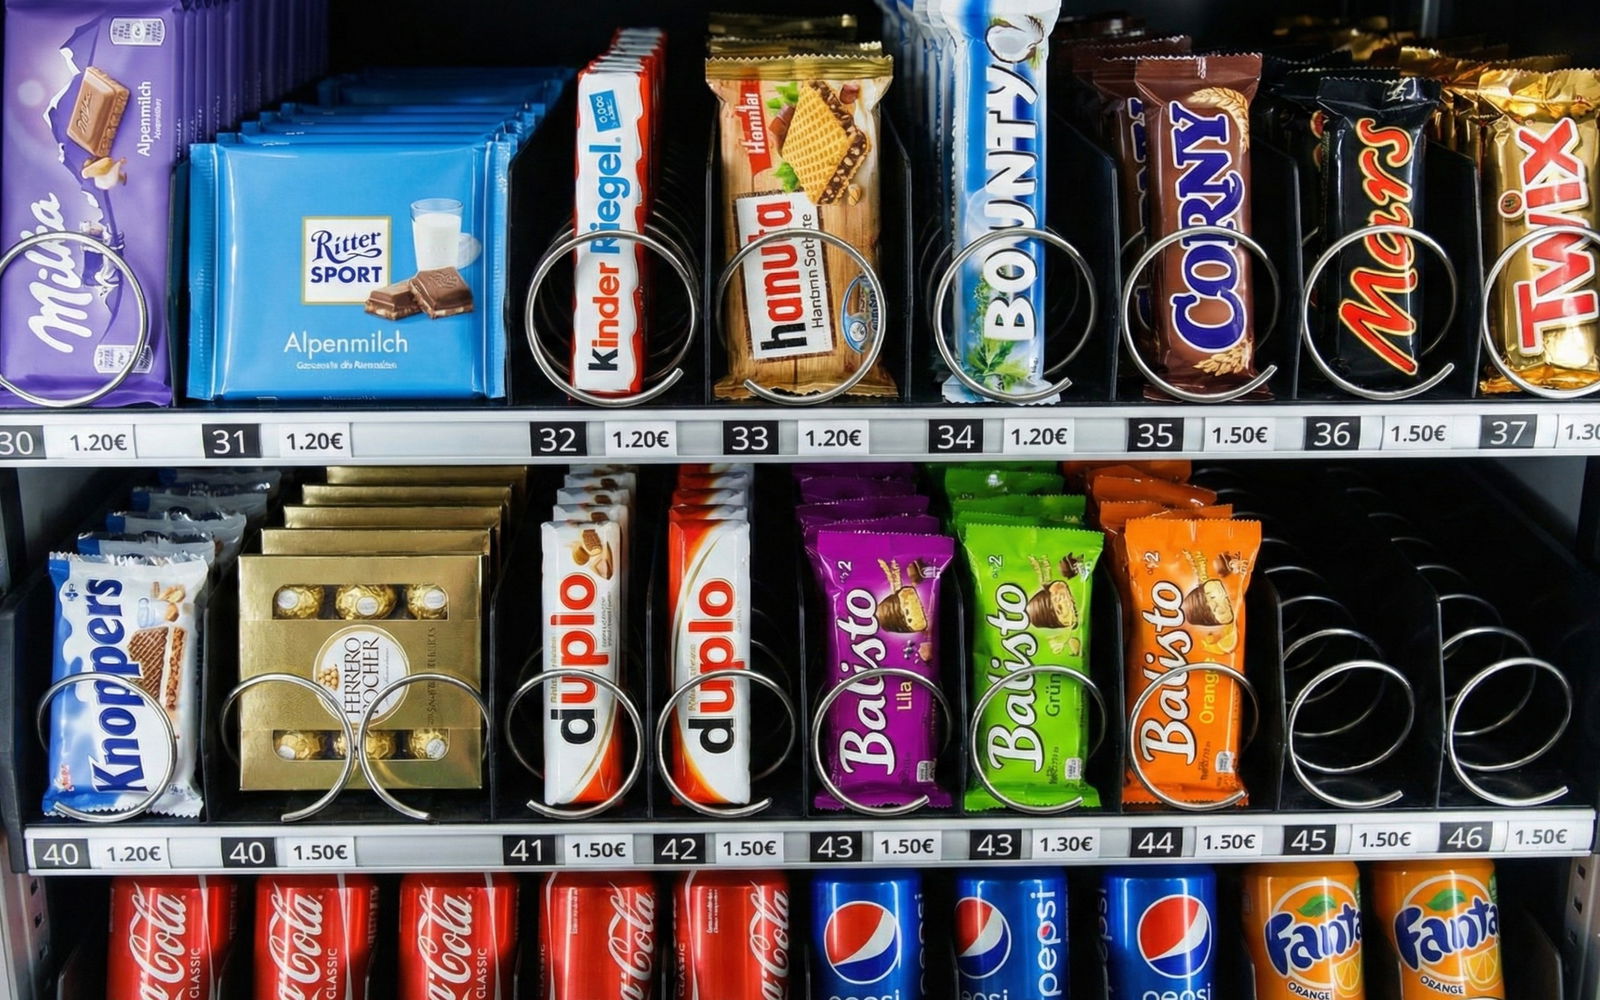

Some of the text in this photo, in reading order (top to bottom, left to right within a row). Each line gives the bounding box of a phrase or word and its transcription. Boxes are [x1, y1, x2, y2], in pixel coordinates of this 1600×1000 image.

[138, 81, 152, 157] Alpenmilch
[984, 63, 1038, 341] BOUNTY
[1169, 101, 1246, 353] CORNY
[311, 230, 383, 263] Ritter
[588, 145, 630, 371] Kinder Riegel
[1339, 118, 1418, 375] Mars
[20, 192, 93, 353] Milka
[311, 266, 383, 283] SPORT
[748, 201, 807, 350] hanuta
[284, 330, 408, 358] Alpenmilch
[0, 431, 33, 455] 30
[70, 434, 127, 451] 1.20€
[212, 429, 245, 454] 31
[286, 433, 343, 450] 1.20€
[540, 428, 577, 452] 32
[612, 431, 670, 448] 1.20€
[731, 426, 769, 450] 33
[805, 429, 862, 447] 1.20€
[937, 425, 975, 449] 34
[1011, 427, 1067, 445] 1.20€
[1136, 423, 1173, 447] 35
[1212, 426, 1267, 443] 1.50€
[1313, 422, 1350, 446] 36
[1391, 425, 1446, 442] 1.50€
[1490, 421, 1527, 445] 37
[550, 573, 609, 744] duplo
[688, 580, 745, 754] duplo
[344, 637, 361, 714] FERRERO
[837, 588, 895, 775] Balisto
[986, 583, 1044, 773] Balisto
[1139, 580, 1197, 766] Balisto
[86, 579, 149, 792] Knoppers
[897, 681, 912, 711] Lila
[1045, 673, 1061, 717] Grün
[661, 838, 697, 860] 42
[722, 840, 777, 856] 1.50€
[817, 836, 853, 858] 43
[881, 838, 934, 854] 1.50€
[977, 834, 1013, 856] 43
[1040, 836, 1093, 852] 1.30€
[1138, 832, 1174, 853] 44
[1203, 834, 1255, 850] 1.50€
[1290, 829, 1327, 851] 45
[1358, 831, 1411, 847] 1.50€
[1446, 826, 1483, 849] 46
[1514, 829, 1567, 845] 1.50€
[43, 843, 78, 865] 40
[106, 846, 161, 862] 1.20€
[230, 842, 266, 864] 40
[293, 844, 347, 860] 1.50€
[510, 839, 542, 862] 41
[572, 842, 626, 858] 1.50€
[1031, 891, 1062, 996] pepsi
[1265, 904, 1361, 976] Fanta
[1394, 897, 1498, 970] Fanta
[190, 948, 201, 998] CLASSIC
[326, 948, 338, 1000] CLASSIC
[476, 948, 487, 998] CLASSIC
[673, 943, 686, 996] CLASSIC
[1287, 982, 1331, 1000] ORANGE
[1420, 976, 1464, 994] ORANGE
